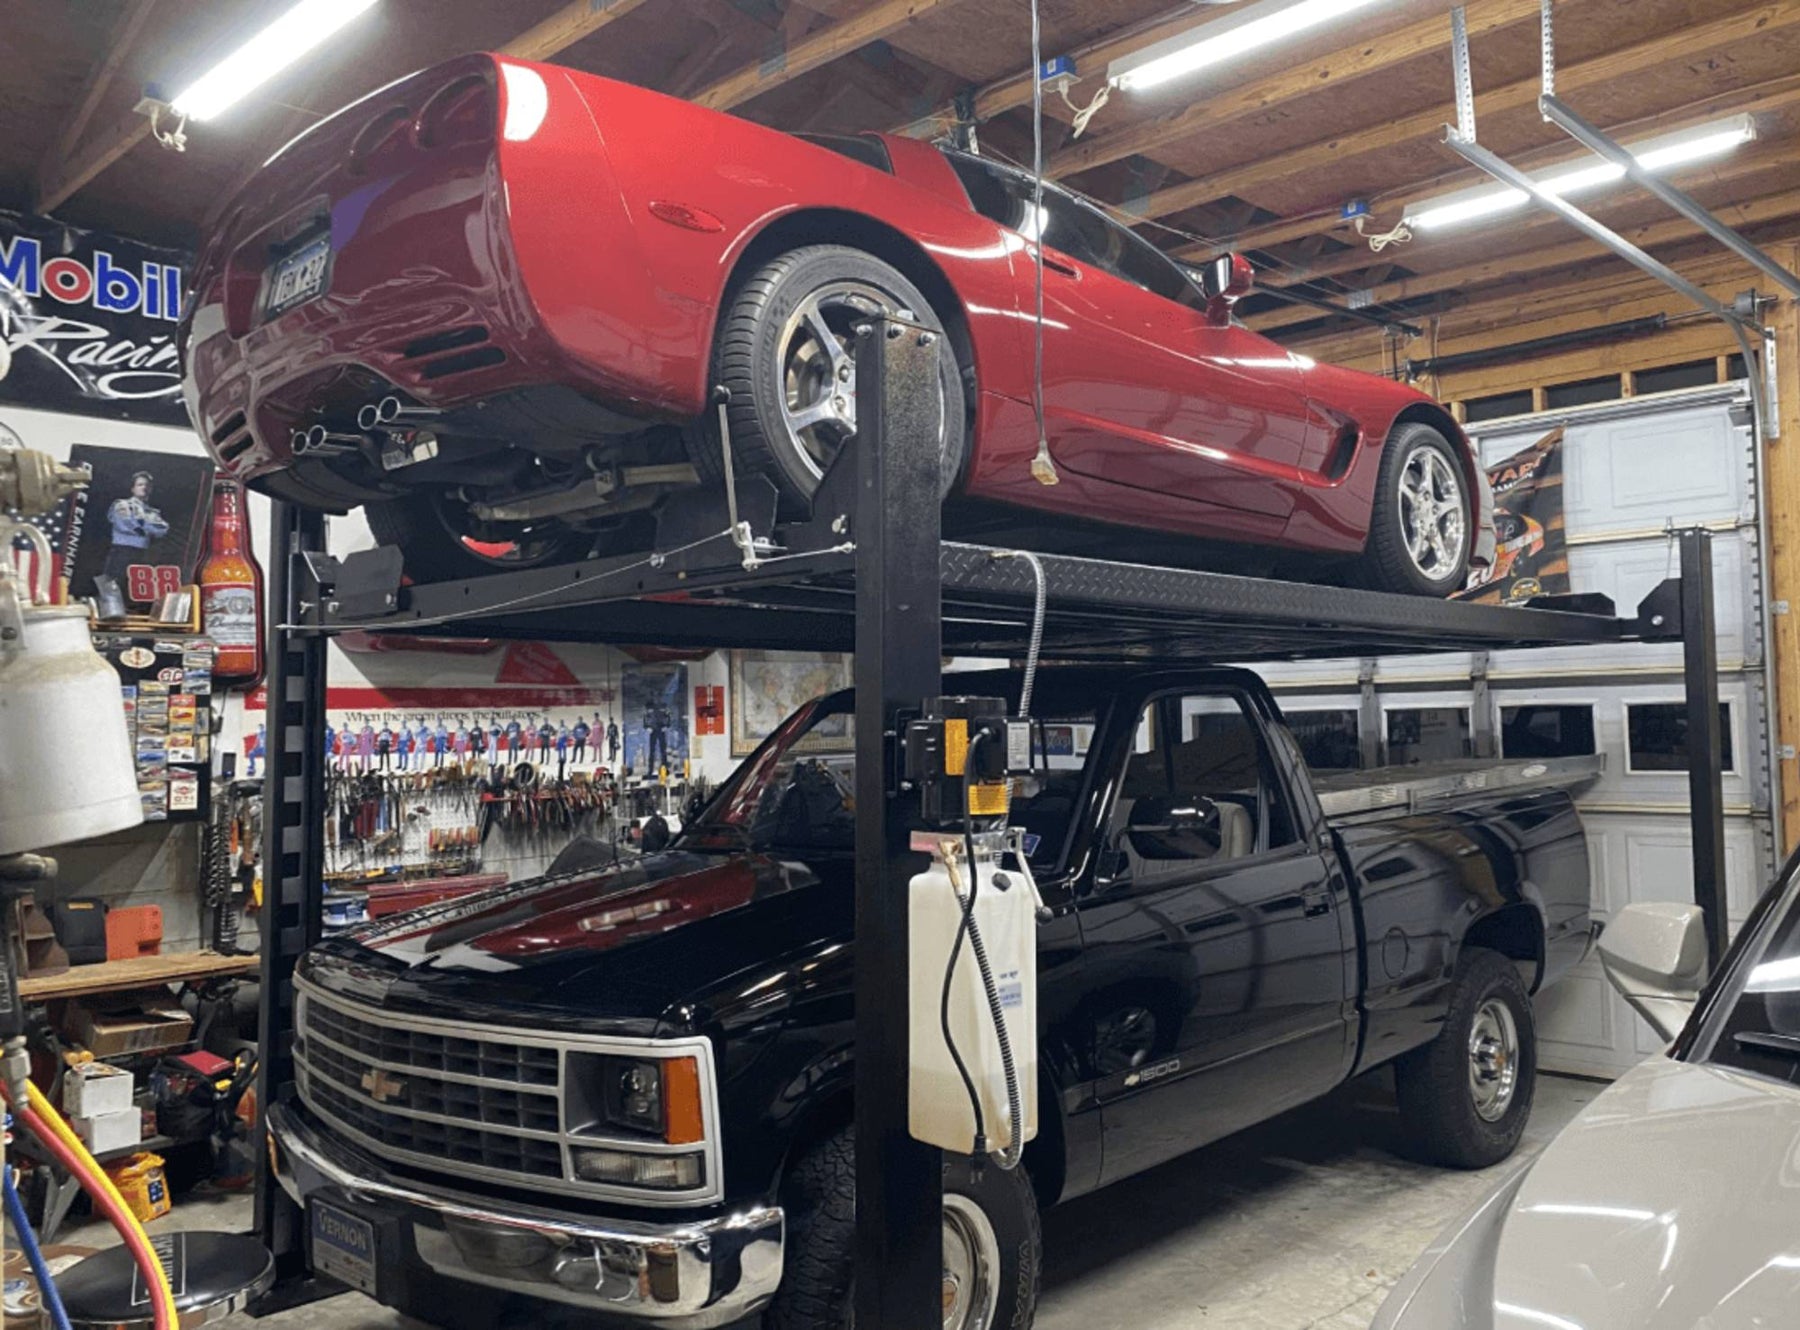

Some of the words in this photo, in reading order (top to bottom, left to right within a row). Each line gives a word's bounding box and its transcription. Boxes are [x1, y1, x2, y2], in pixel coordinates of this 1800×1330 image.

[0, 236, 181, 322] Mobil
[64, 507, 86, 577] EARNHAR
[128, 564, 181, 601] 88
[345, 711, 381, 722] When
[383, 711, 402, 721] the
[403, 712, 436, 723] green
[1140, 1059, 1180, 1083] 1500
[318, 1206, 367, 1252] VERNON
